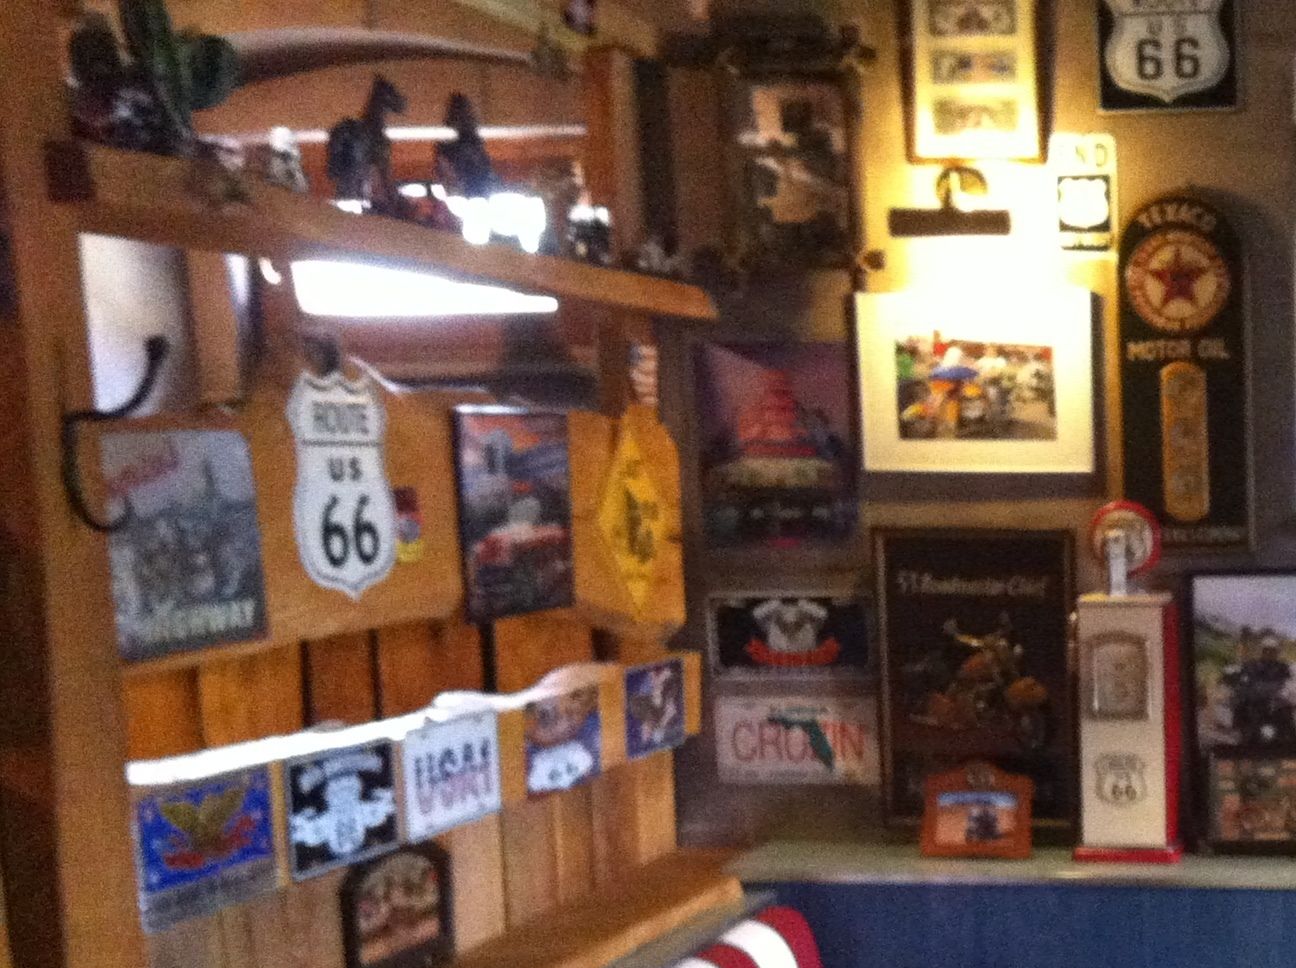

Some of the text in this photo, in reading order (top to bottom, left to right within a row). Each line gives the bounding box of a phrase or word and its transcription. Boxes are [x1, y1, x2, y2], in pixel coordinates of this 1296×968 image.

[1136, 37, 1200, 80] 66
[1136, 201, 1217, 232] TEXACO
[1126, 337, 1231, 361] MOTOR OIL
[312, 402, 370, 433] ROUTE
[328, 456, 364, 481] US
[320, 494, 380, 568] 66
